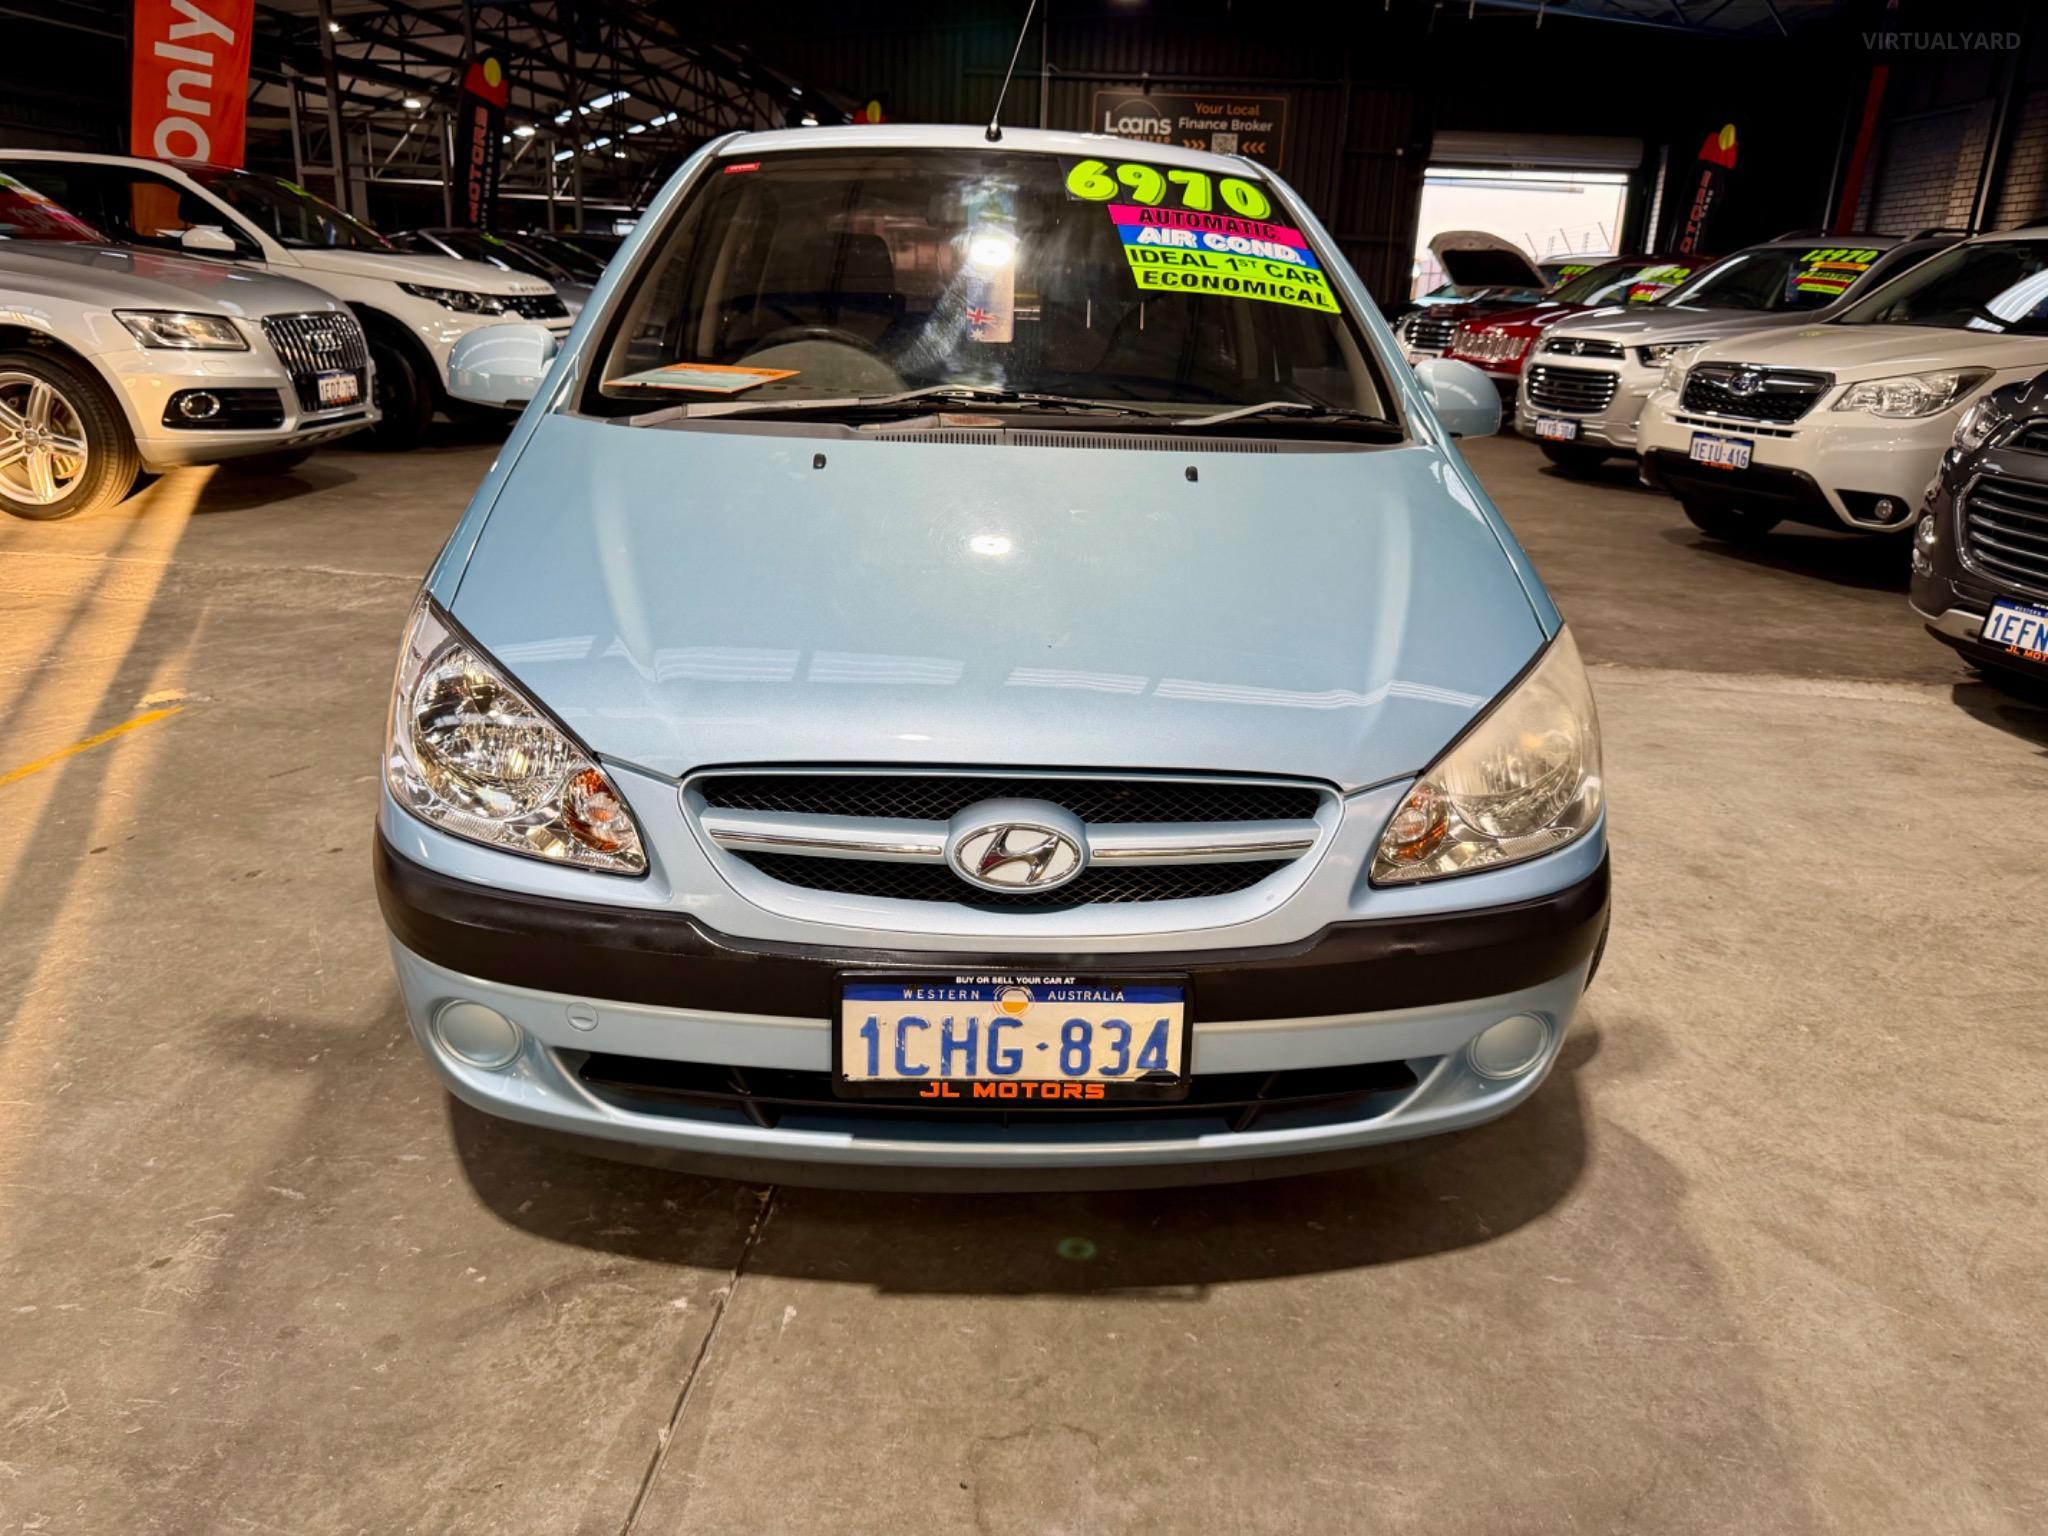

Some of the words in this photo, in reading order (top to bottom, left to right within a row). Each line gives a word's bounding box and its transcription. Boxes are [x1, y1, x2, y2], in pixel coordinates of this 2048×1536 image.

[154, 0, 235, 163] Only
[1195, 103, 1224, 115] Your
[1227, 104, 1260, 116] Local
[1104, 110, 1172, 136] Loans
[1178, 116, 1229, 131] Finance
[1231, 118, 1273, 132] Broker
[1066, 159, 1272, 220] 6970
[1138, 207, 1279, 240] AUTOMATIC
[1679, 169, 1713, 254] OTORS
[1137, 226, 1198, 248] AIR
[1131, 248, 1219, 269] IDEAL
[1225, 257, 1258, 272] 1ST
[1265, 265, 1324, 288] CAR
[1143, 270, 1332, 308] ECONOMICAL
[956, 976, 974, 984] BUY
[976, 976, 989, 984] OR
[991, 976, 1014, 984] SELL
[903, 989, 981, 1000] WESTERN
[1048, 990, 1125, 1001] AUSTRALIA
[919, 1081, 960, 1098] JL
[973, 1082, 1105, 1099] MOTORS
